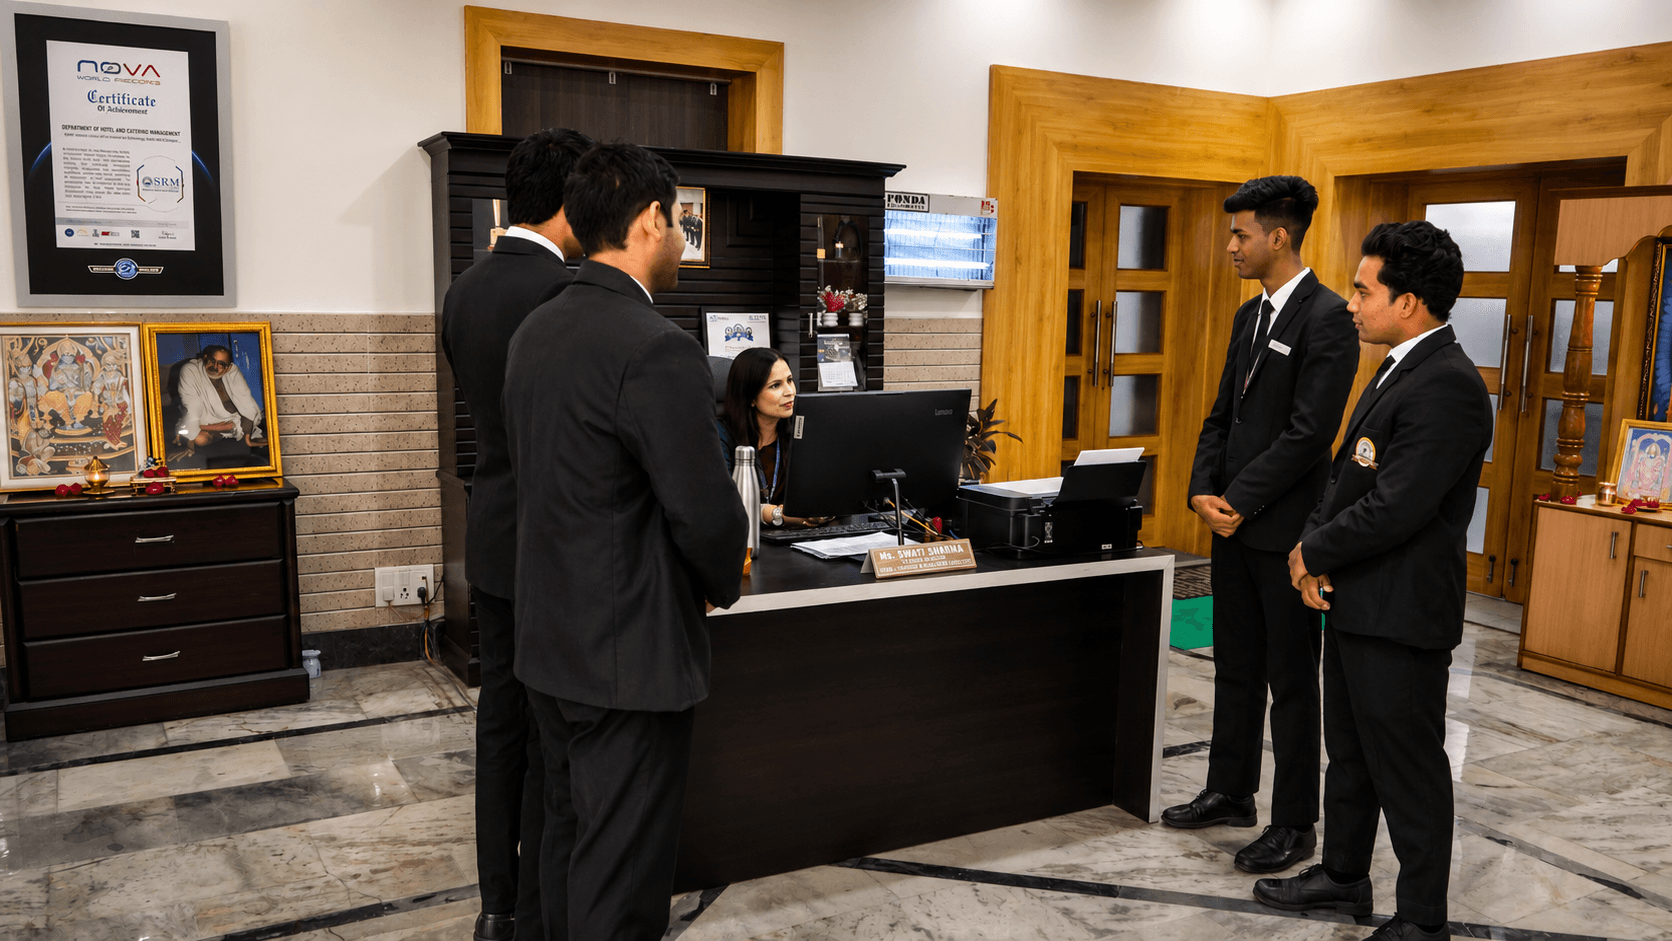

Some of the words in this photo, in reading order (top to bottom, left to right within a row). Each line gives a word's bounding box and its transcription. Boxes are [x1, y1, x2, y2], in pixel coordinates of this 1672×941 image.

[87, 89, 156, 107] Certificate
[107, 106, 148, 115] Achievement
[154, 177, 179, 187] SRM
[897, 548, 925, 559] SWATI
[928, 544, 964, 556] SHARMA
